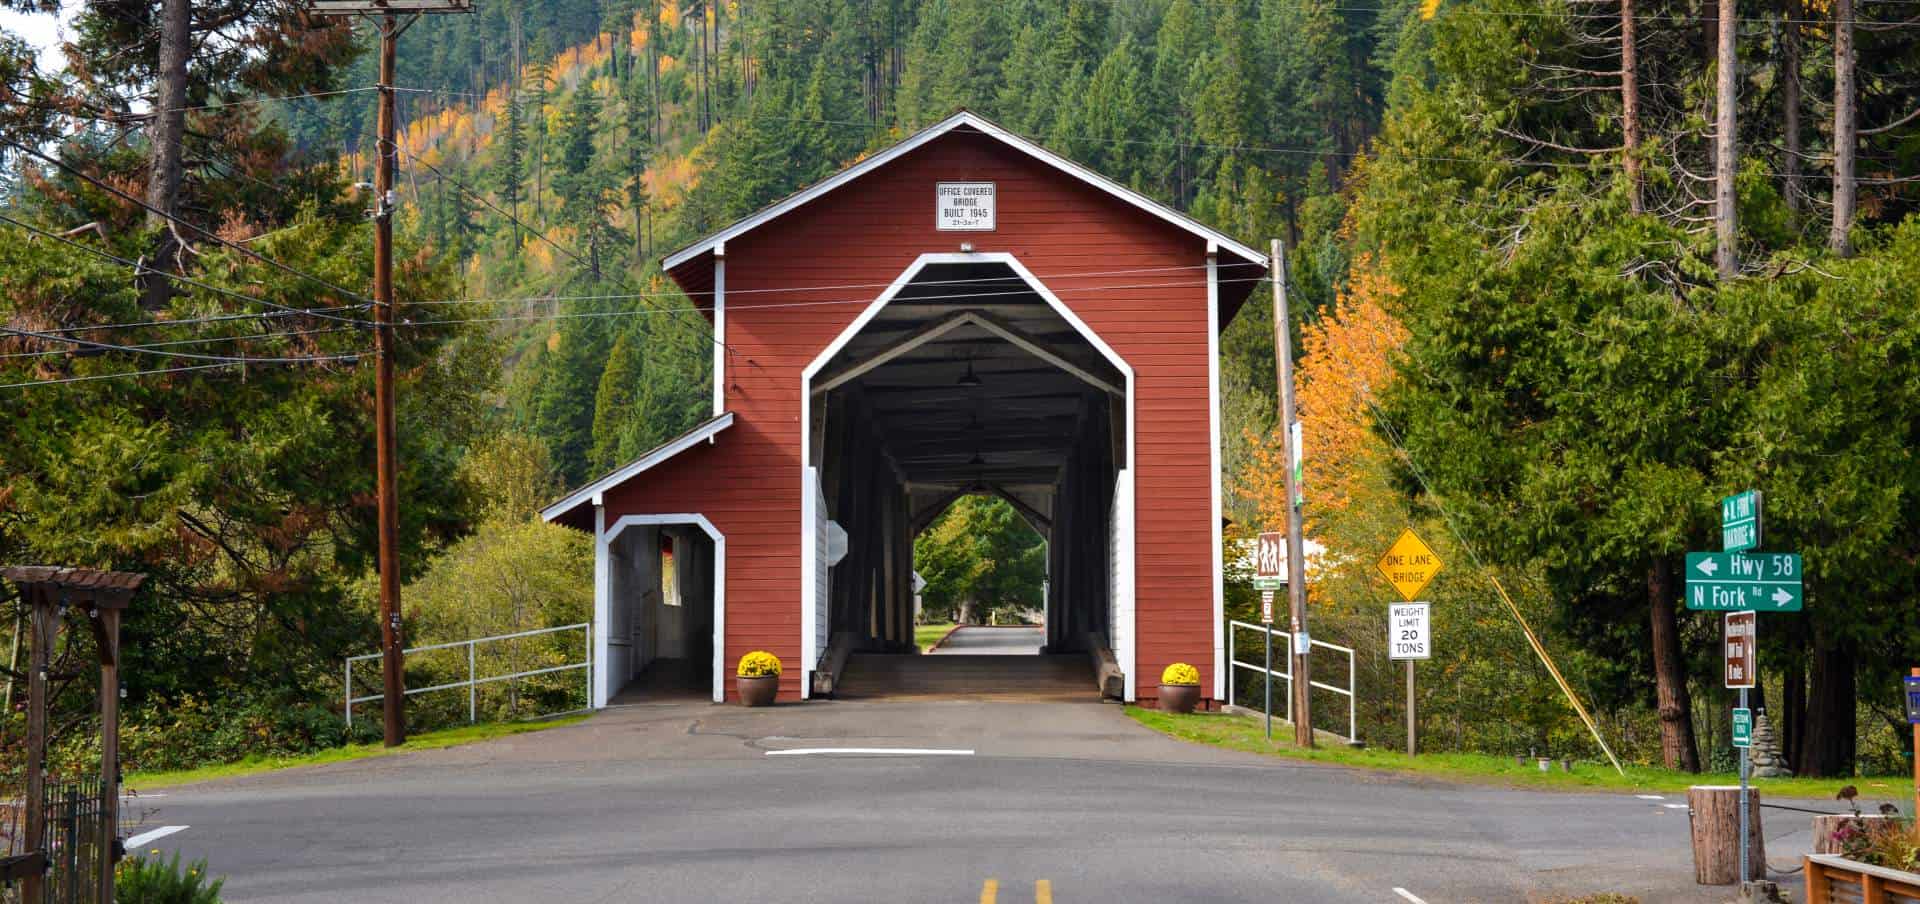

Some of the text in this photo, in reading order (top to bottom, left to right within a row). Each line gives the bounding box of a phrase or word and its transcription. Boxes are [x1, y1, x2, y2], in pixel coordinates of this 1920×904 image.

[940, 187, 993, 196] OFFICE COVERED
[953, 198, 978, 206] BRIDGE
[944, 208, 988, 218] BUILT 1945
[1387, 554, 1432, 566] ONE LANE
[1731, 554, 1793, 581] Hwy 58
[1393, 571, 1425, 583] BRIDGE
[1694, 585, 1762, 607] N Fork Rd
[1394, 607, 1425, 617] WEIGHT
[1399, 618, 1420, 628] LIMIT
[1401, 629, 1418, 641] 20
[1396, 643, 1424, 654] TONS
